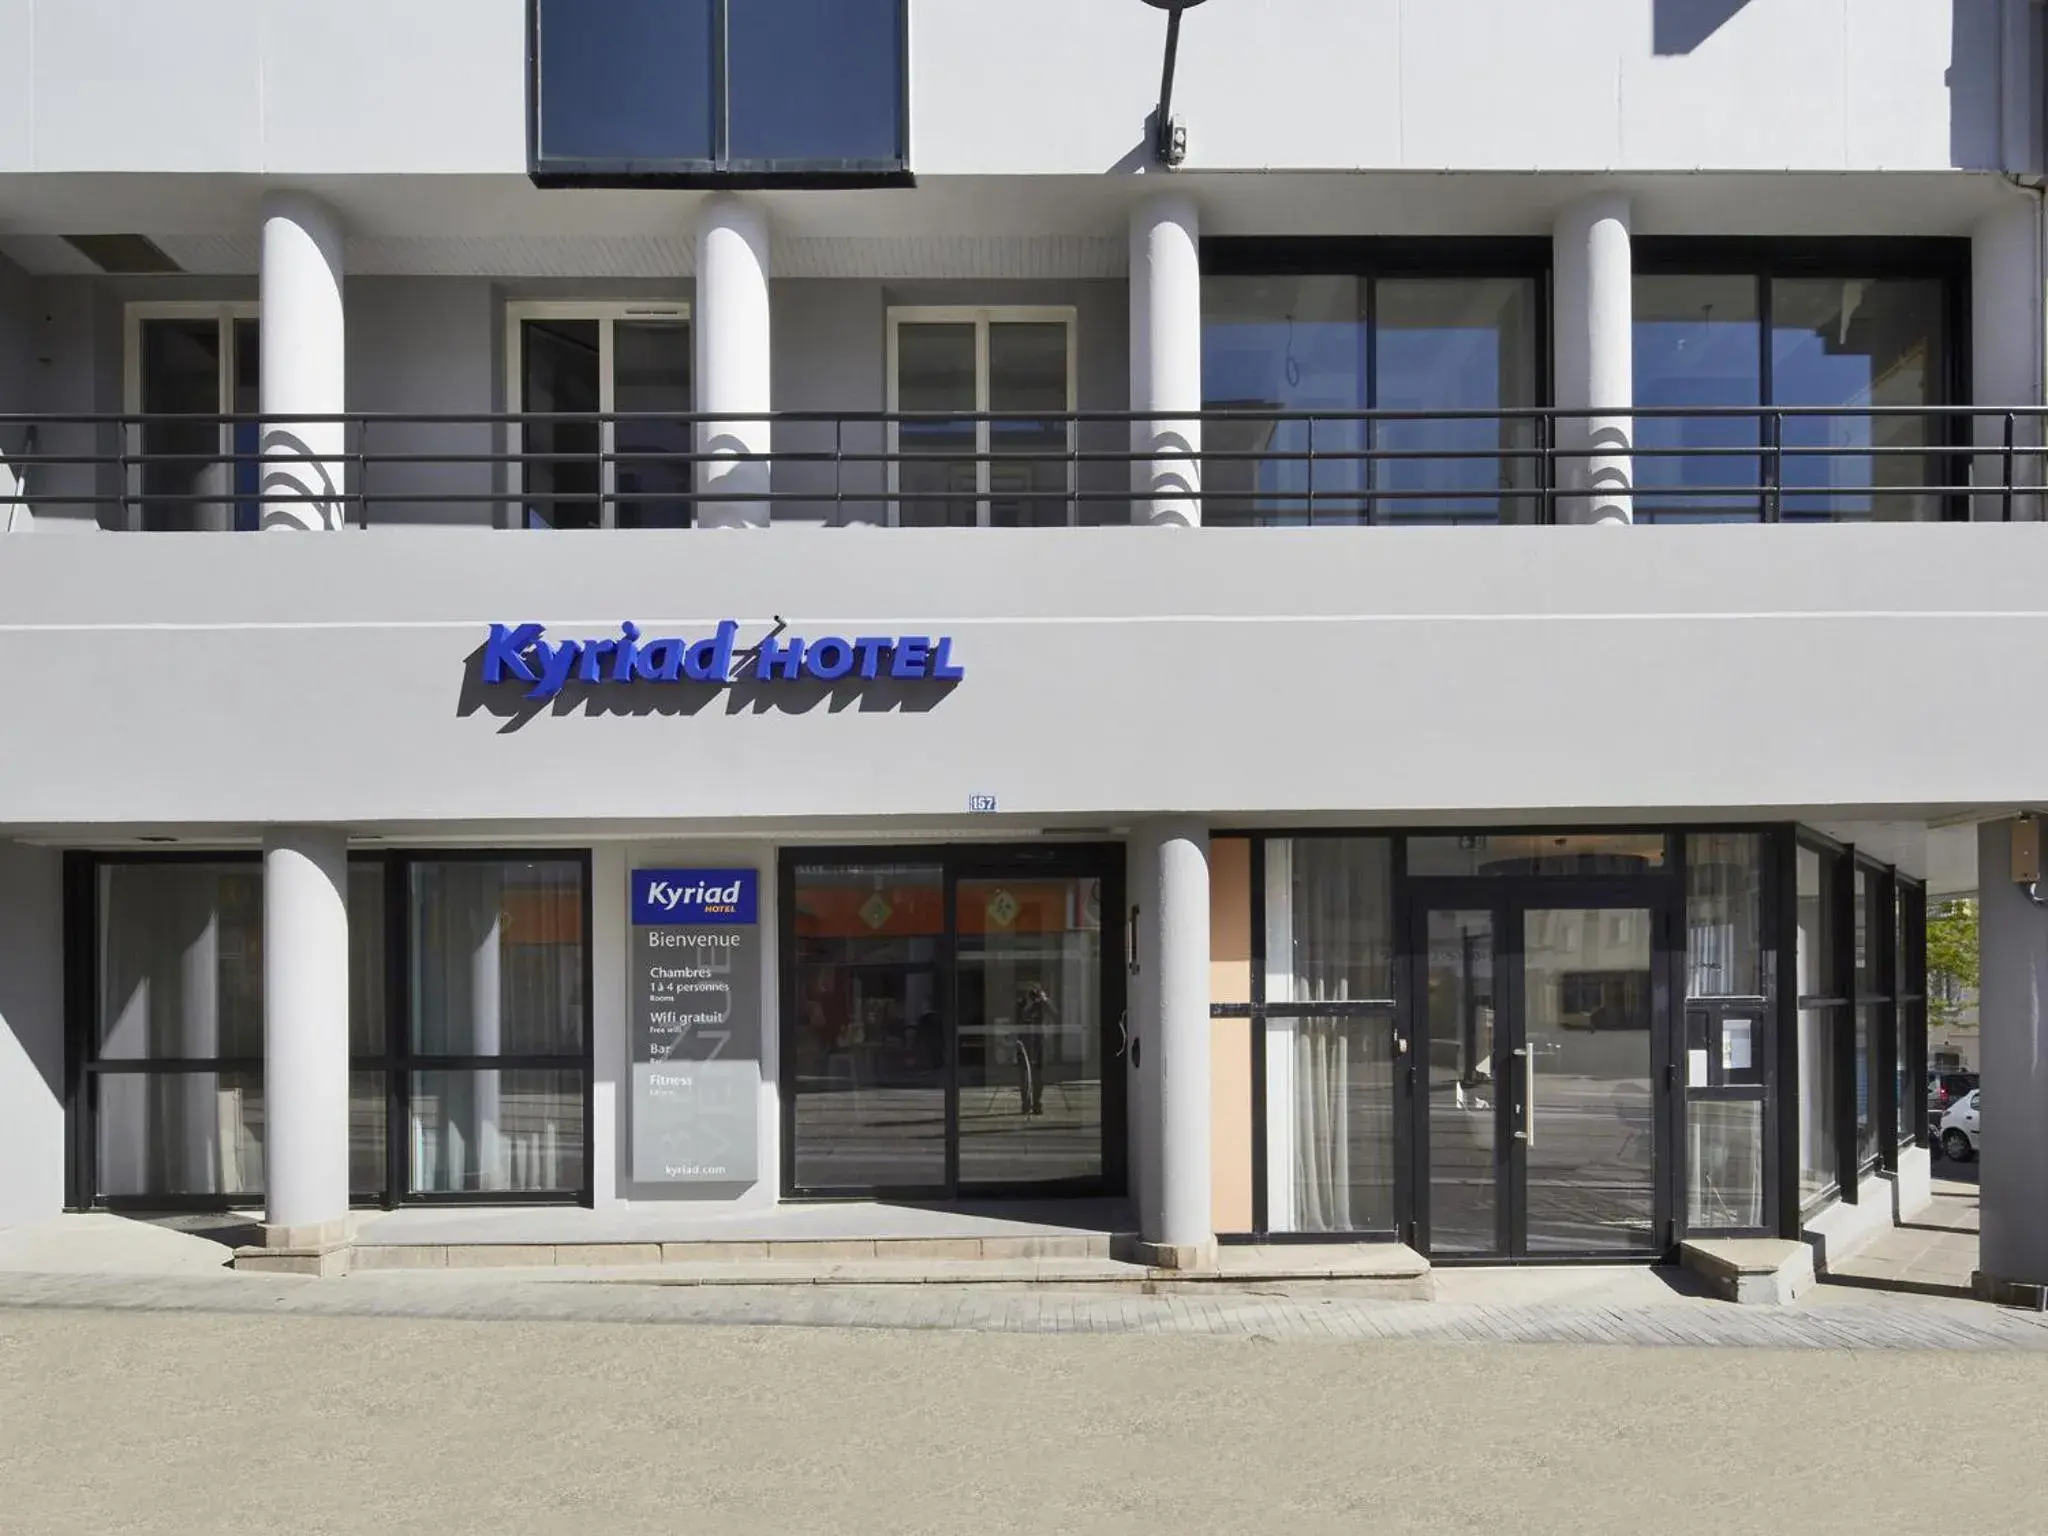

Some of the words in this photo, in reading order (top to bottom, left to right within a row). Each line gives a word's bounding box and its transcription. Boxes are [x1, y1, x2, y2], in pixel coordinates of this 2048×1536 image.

[481, 620, 739, 699] Kyriad
[754, 636, 965, 681] HOTEL
[647, 880, 741, 910] Kyriad
[704, 905, 737, 913] HOTEL
[648, 932, 741, 947] Bienvenue
[650, 967, 712, 979] Chambres
[651, 982, 656, 992] 1
[667, 982, 674, 992] 4
[676, 983, 730, 995] personnes
[650, 1011, 676, 1023] Wifi
[679, 1011, 722, 1026] gratuit
[650, 1043, 671, 1054] Bar
[650, 1074, 692, 1086] Fitness
[665, 1163, 727, 1177] kyriad.com
